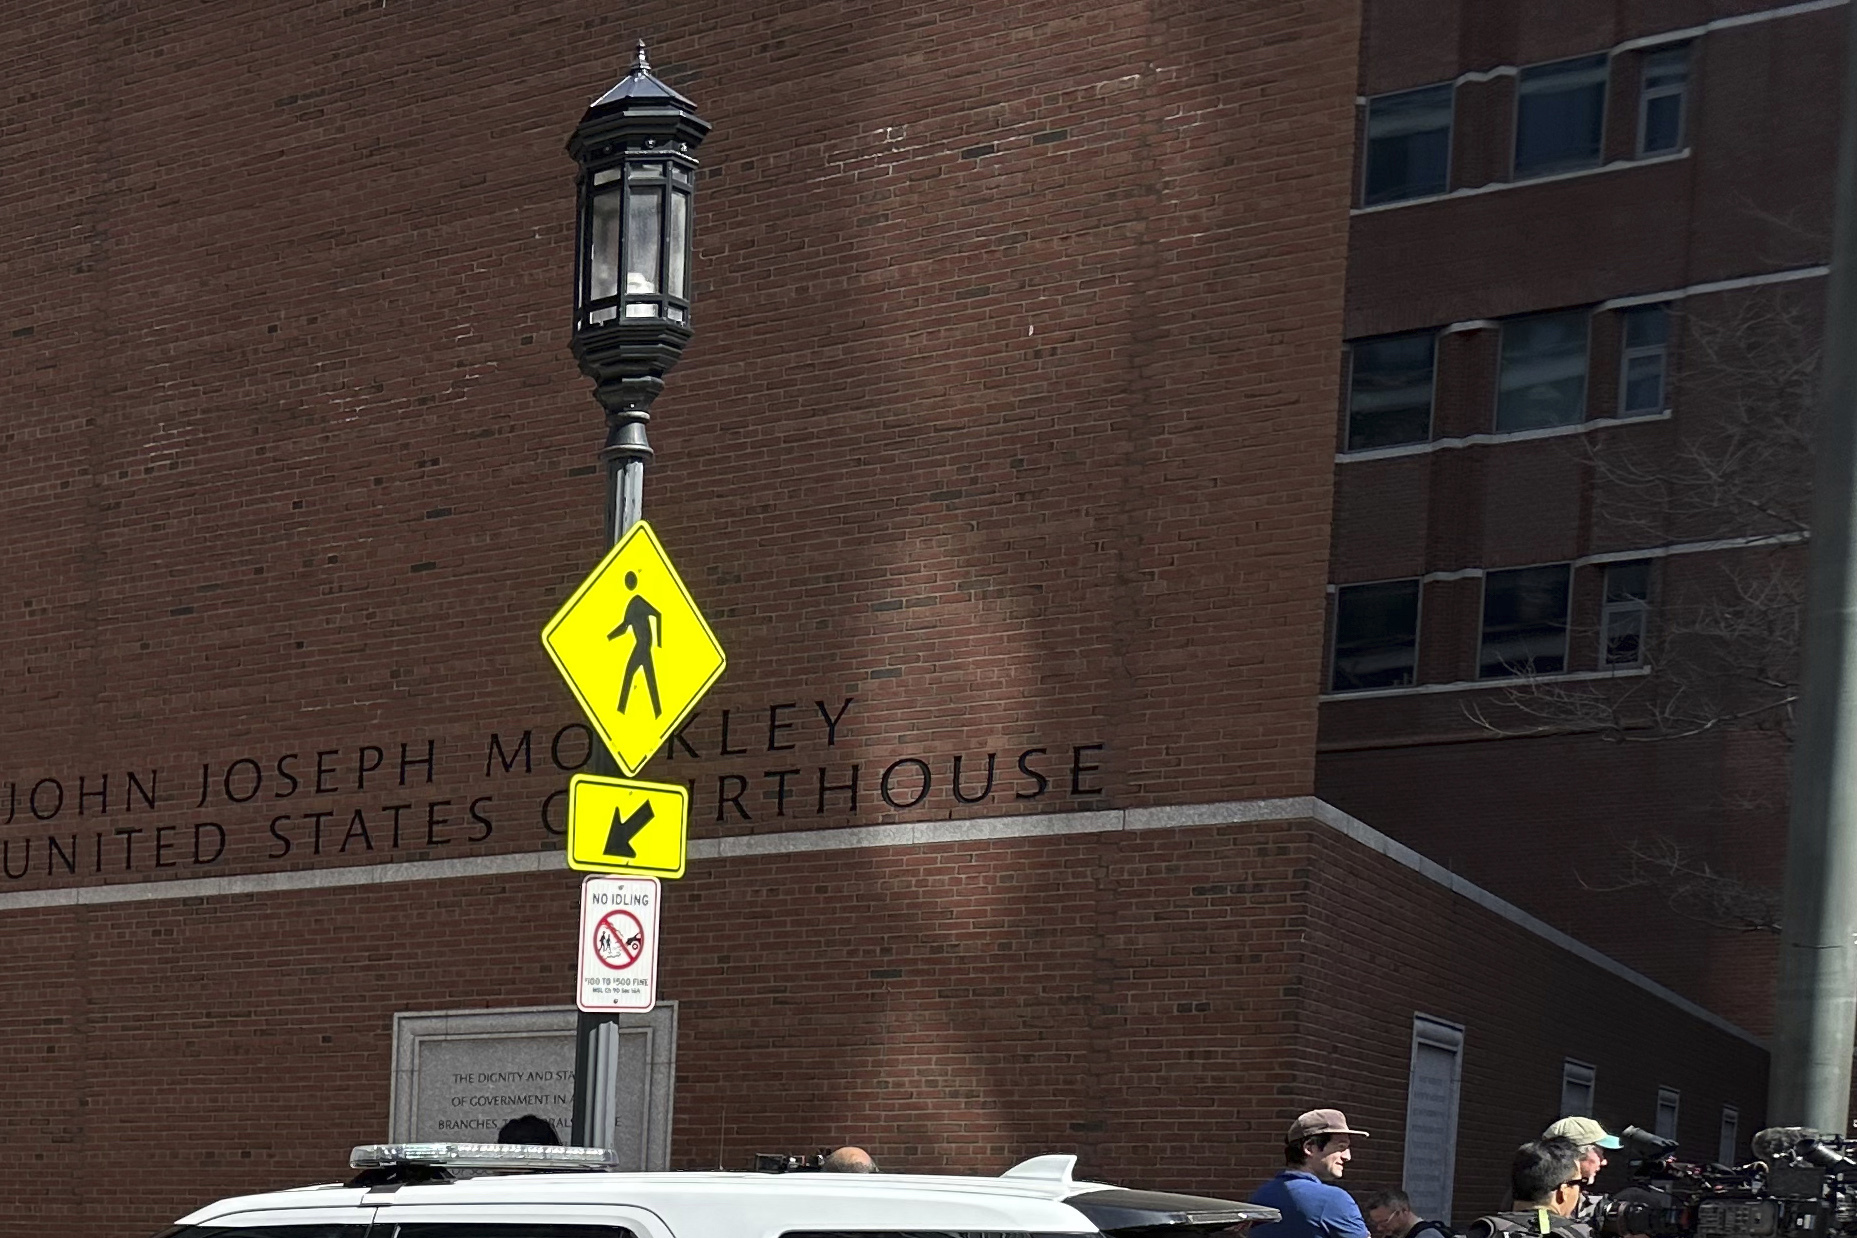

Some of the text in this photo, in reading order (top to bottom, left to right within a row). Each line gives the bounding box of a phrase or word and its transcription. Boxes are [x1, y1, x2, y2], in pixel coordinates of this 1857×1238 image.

[4, 697, 854, 825] JOHN JOSEPH MOKLEY
[2, 743, 1104, 880] UNITED STATES CRTHOUSE
[592, 892, 649, 907] NO IDLING
[602, 977, 611, 986] TO
[453, 1072, 475, 1084] THE
[477, 1071, 525, 1083] DIGNITY
[525, 1071, 553, 1082] AND
[451, 1096, 468, 1108] OF
[469, 1094, 550, 1108] GOVERNMENT
[553, 1094, 566, 1105] IN
